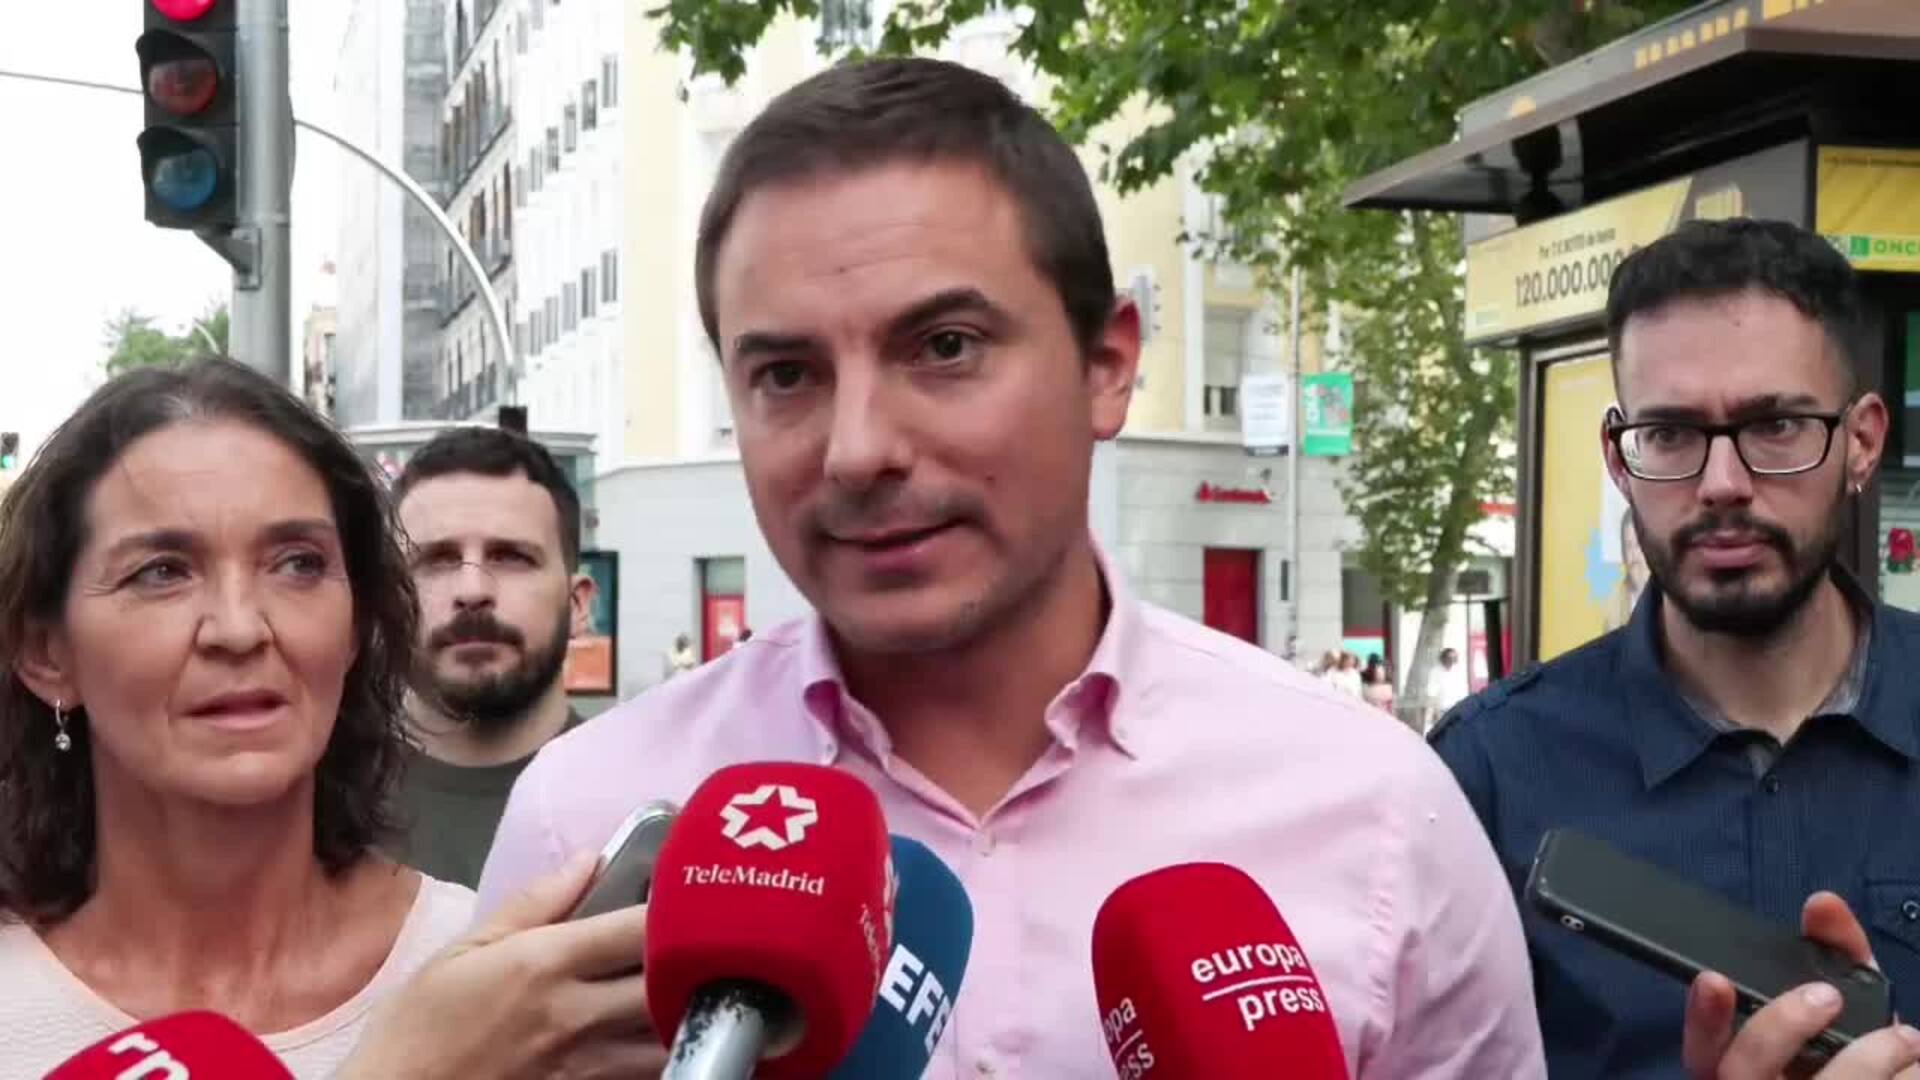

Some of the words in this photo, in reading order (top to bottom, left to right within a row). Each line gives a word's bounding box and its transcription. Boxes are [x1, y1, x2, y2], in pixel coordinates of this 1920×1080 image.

[1874, 239, 1920, 254] ONC
[683, 863, 825, 896] TeleMadrid
[1190, 943, 1306, 983] europa
[1236, 986, 1325, 1031] press
